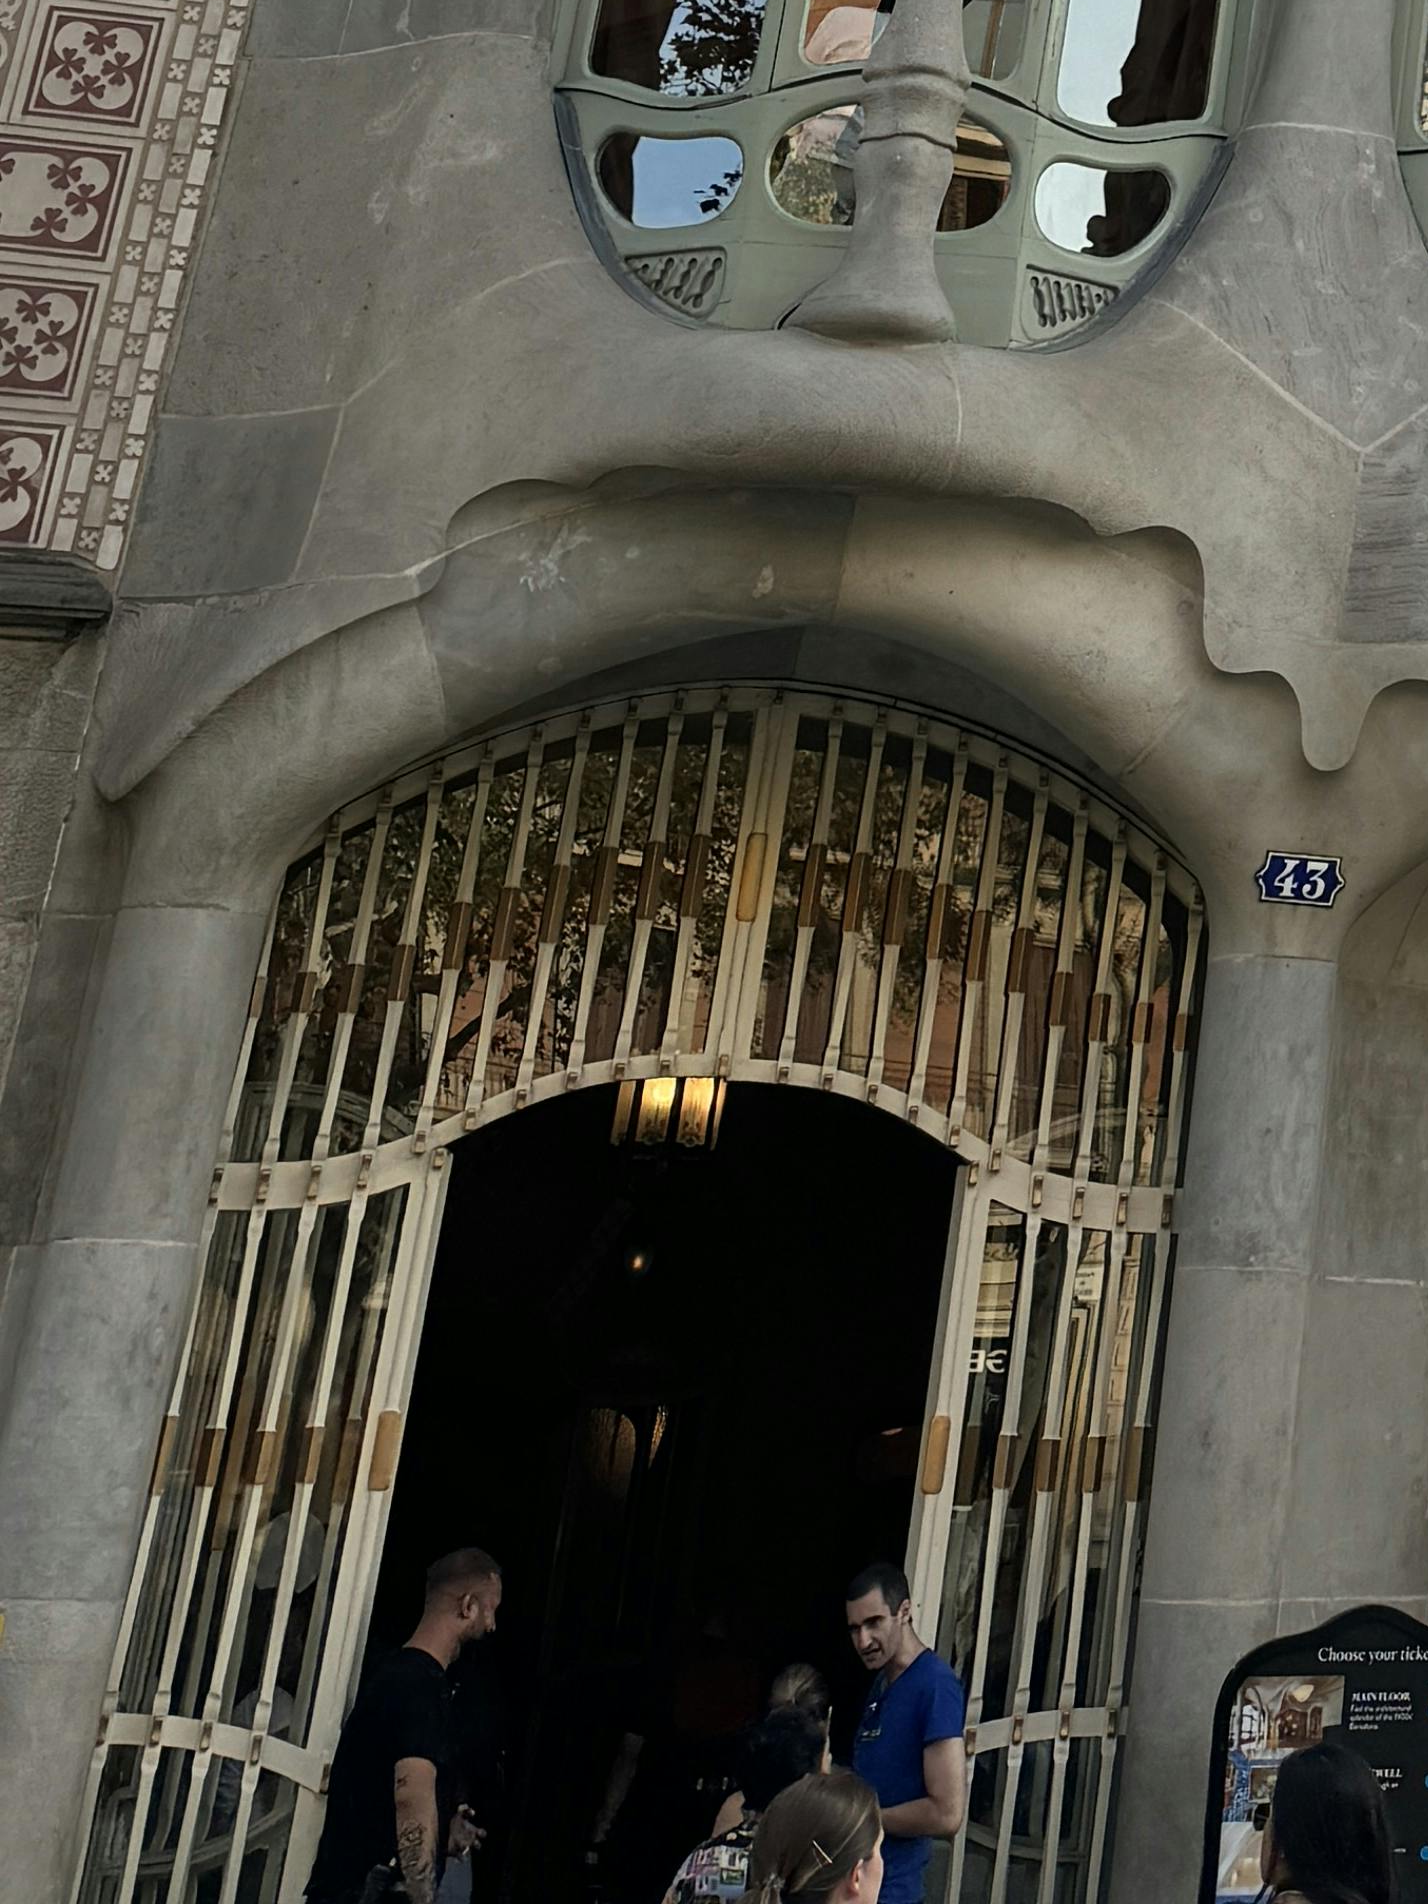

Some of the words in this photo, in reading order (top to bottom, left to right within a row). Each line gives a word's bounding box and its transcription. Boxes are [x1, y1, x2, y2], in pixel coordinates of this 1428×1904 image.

[1273, 858, 1329, 899] 43
[1318, 1646, 1366, 1663] Choose
[1369, 1649, 1398, 1666] your
